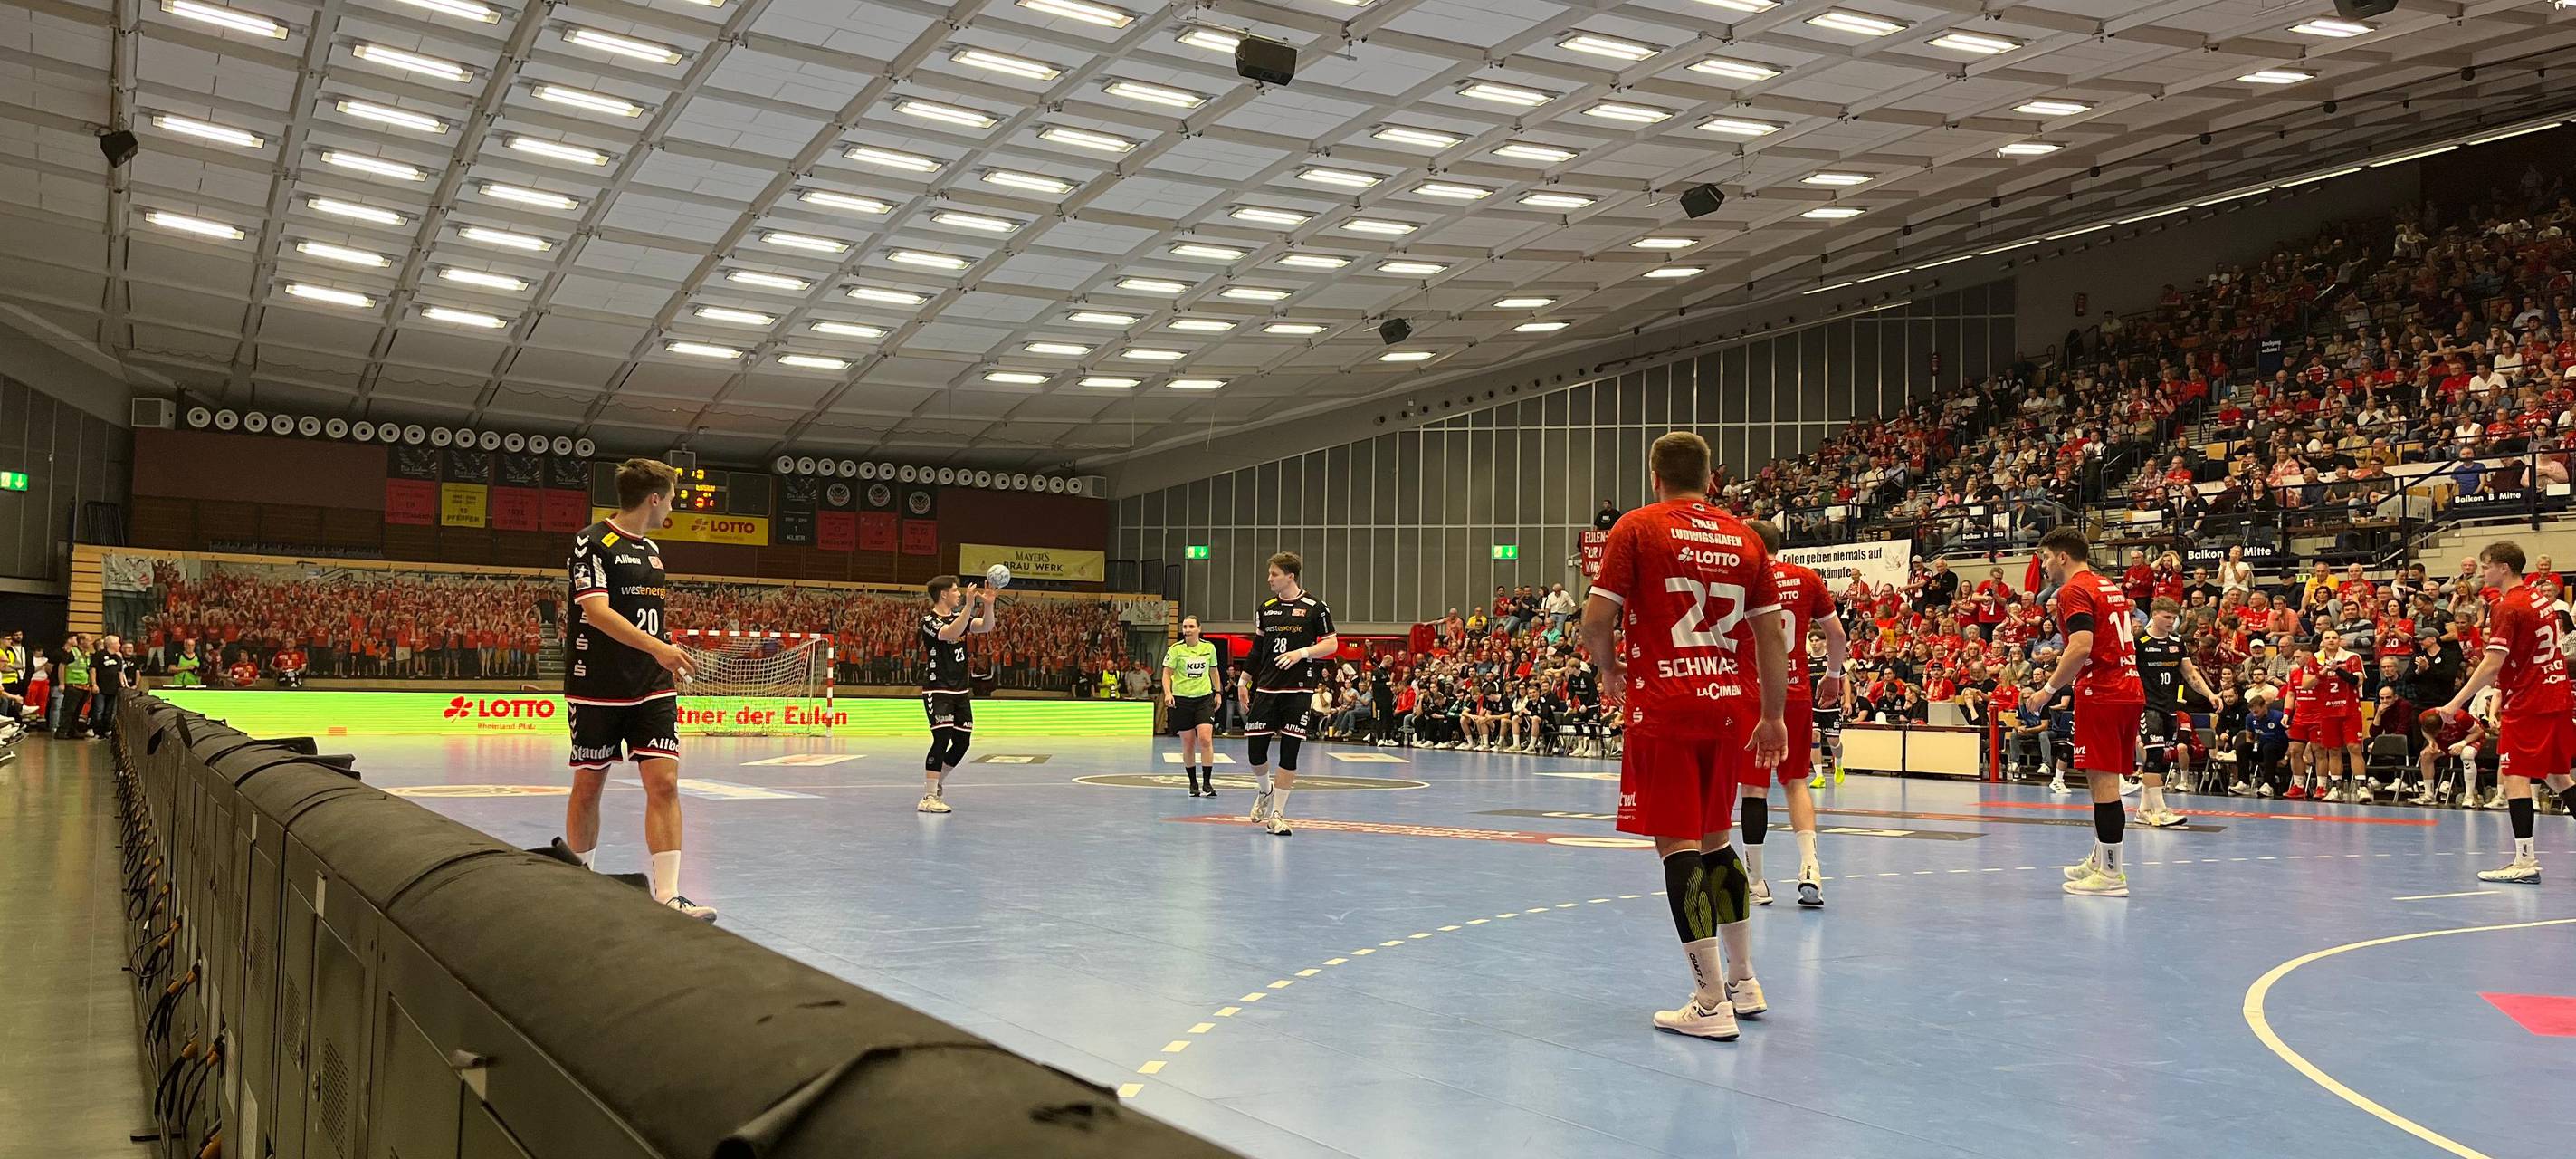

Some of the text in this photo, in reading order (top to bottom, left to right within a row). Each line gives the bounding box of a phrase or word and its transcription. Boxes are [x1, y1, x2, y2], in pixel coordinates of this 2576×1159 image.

[2454, 495, 2484, 503] Balkon
[2499, 492, 2522, 501] Mitte
[711, 520, 755, 534] LOTTO
[1670, 528, 1743, 547] LUDWIGSHAFEN
[1695, 550, 1741, 567] LOTTO
[1806, 553, 1832, 565] geben
[1833, 548, 1866, 562] niemals
[1868, 547, 1883, 560] auf
[2187, 546, 2272, 560] Balkon Mitte
[1035, 563, 1064, 572] WERK
[636, 608, 659, 636] 20
[1665, 577, 1746, 653] 22
[1273, 637, 1287, 653] 28
[2160, 672, 2171, 685] 10
[2329, 682, 2339, 693] 2
[478, 698, 555, 718] LOTTO
[677, 706, 727, 725] tner
[735, 705, 776, 724] der
[571, 744, 615, 761] Stauder
[1689, 953, 1703, 978] CRAFT
